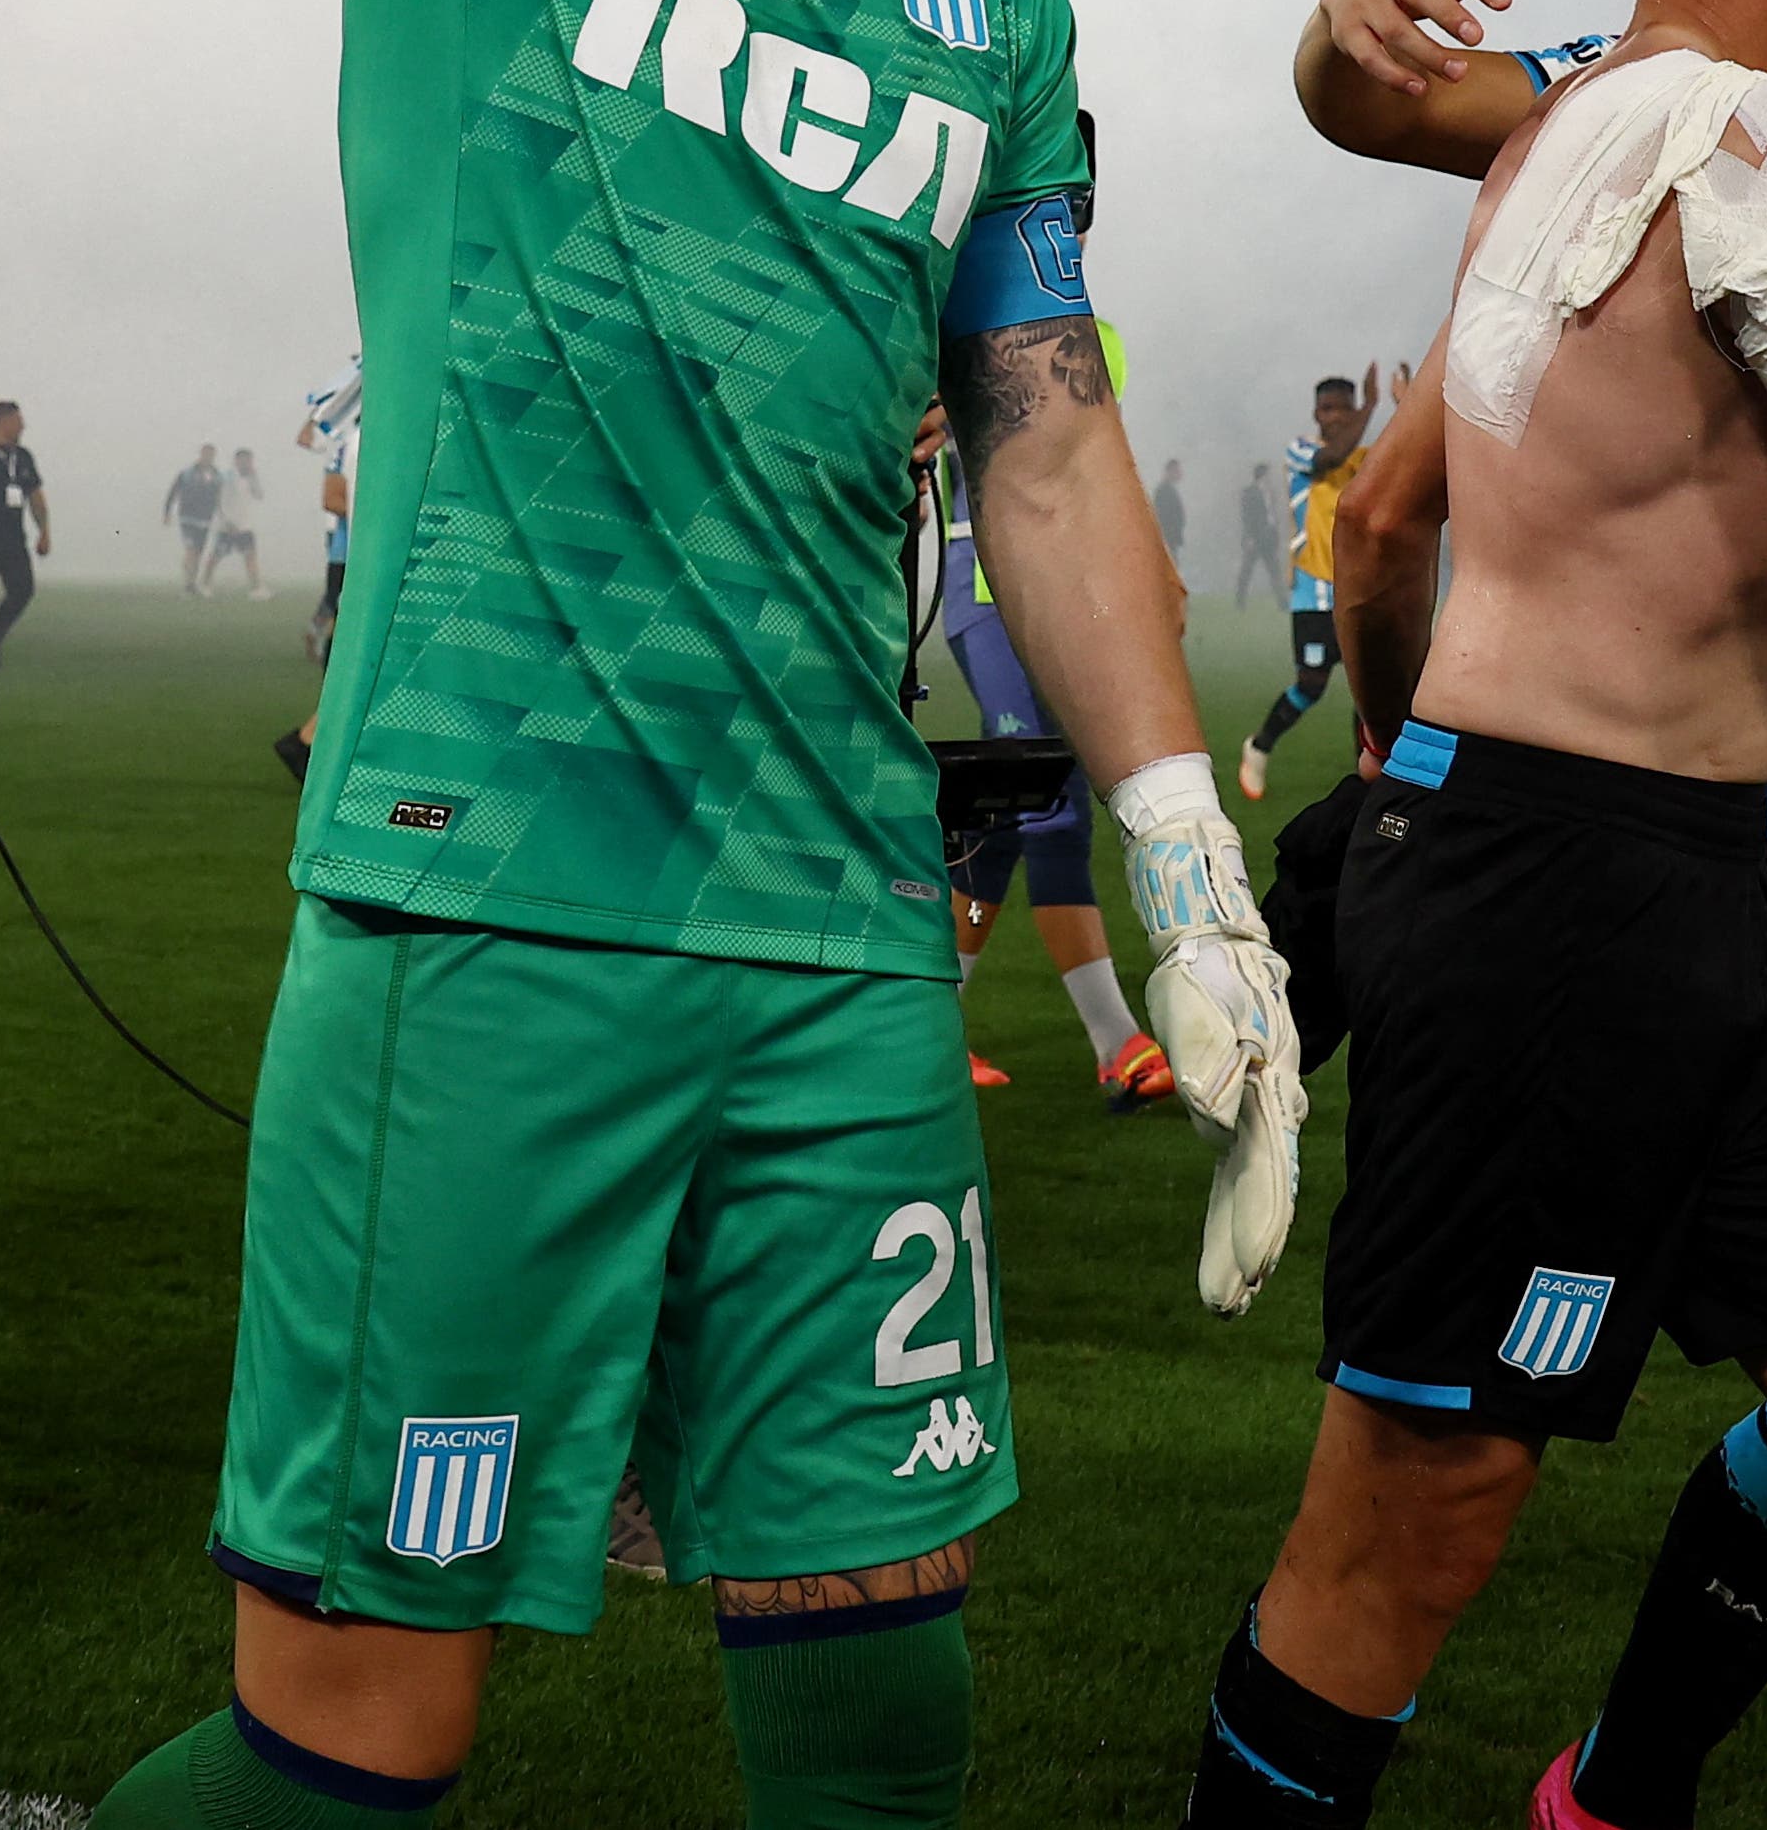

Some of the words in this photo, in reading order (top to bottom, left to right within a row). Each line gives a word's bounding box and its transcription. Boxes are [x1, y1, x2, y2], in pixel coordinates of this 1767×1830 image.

[1016, 193, 1086, 303] C
[871, 1185, 995, 1387] 21
[1536, 1277, 1605, 1299] RACING
[412, 1429, 507, 1448] RACING
